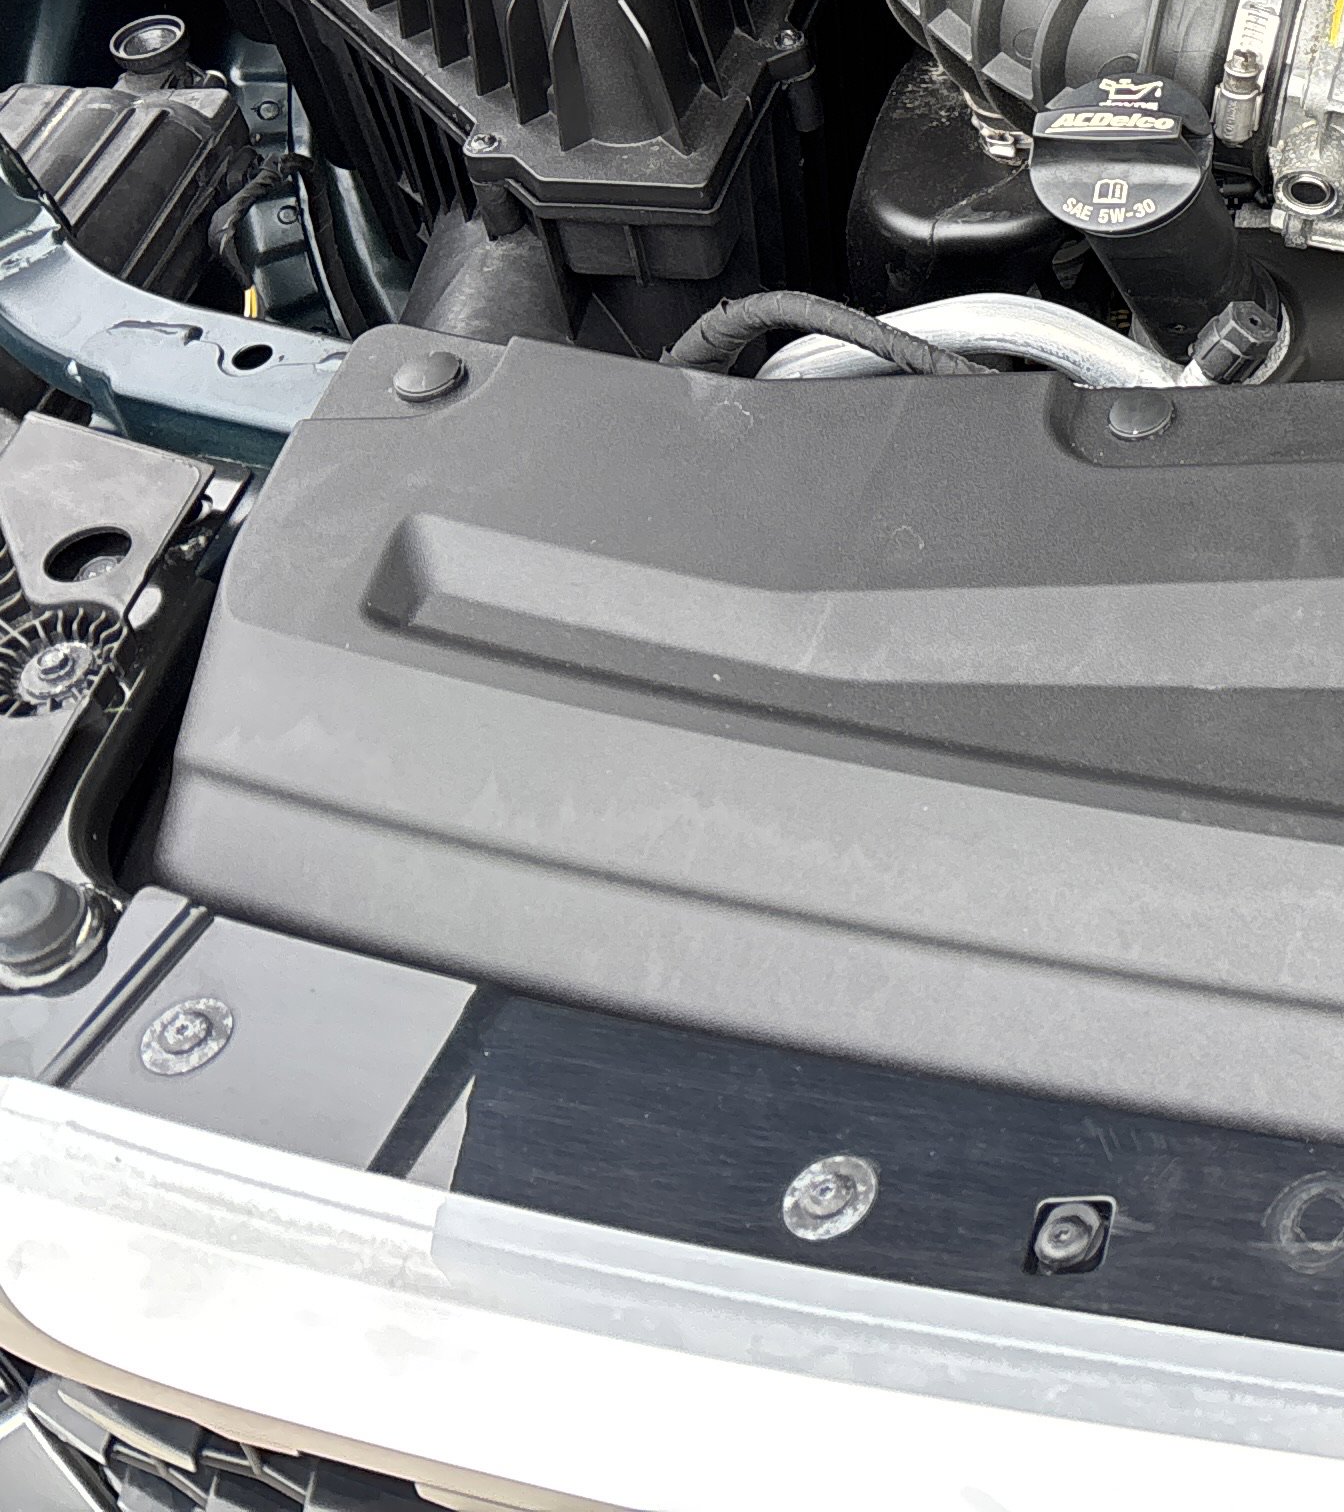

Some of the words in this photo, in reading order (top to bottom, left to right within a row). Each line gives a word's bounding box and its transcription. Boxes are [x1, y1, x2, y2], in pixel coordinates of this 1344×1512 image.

[1050, 112, 1175, 129] ACDelco
[1062, 197, 1094, 222] SAE
[1097, 198, 1156, 224] 5W-30
